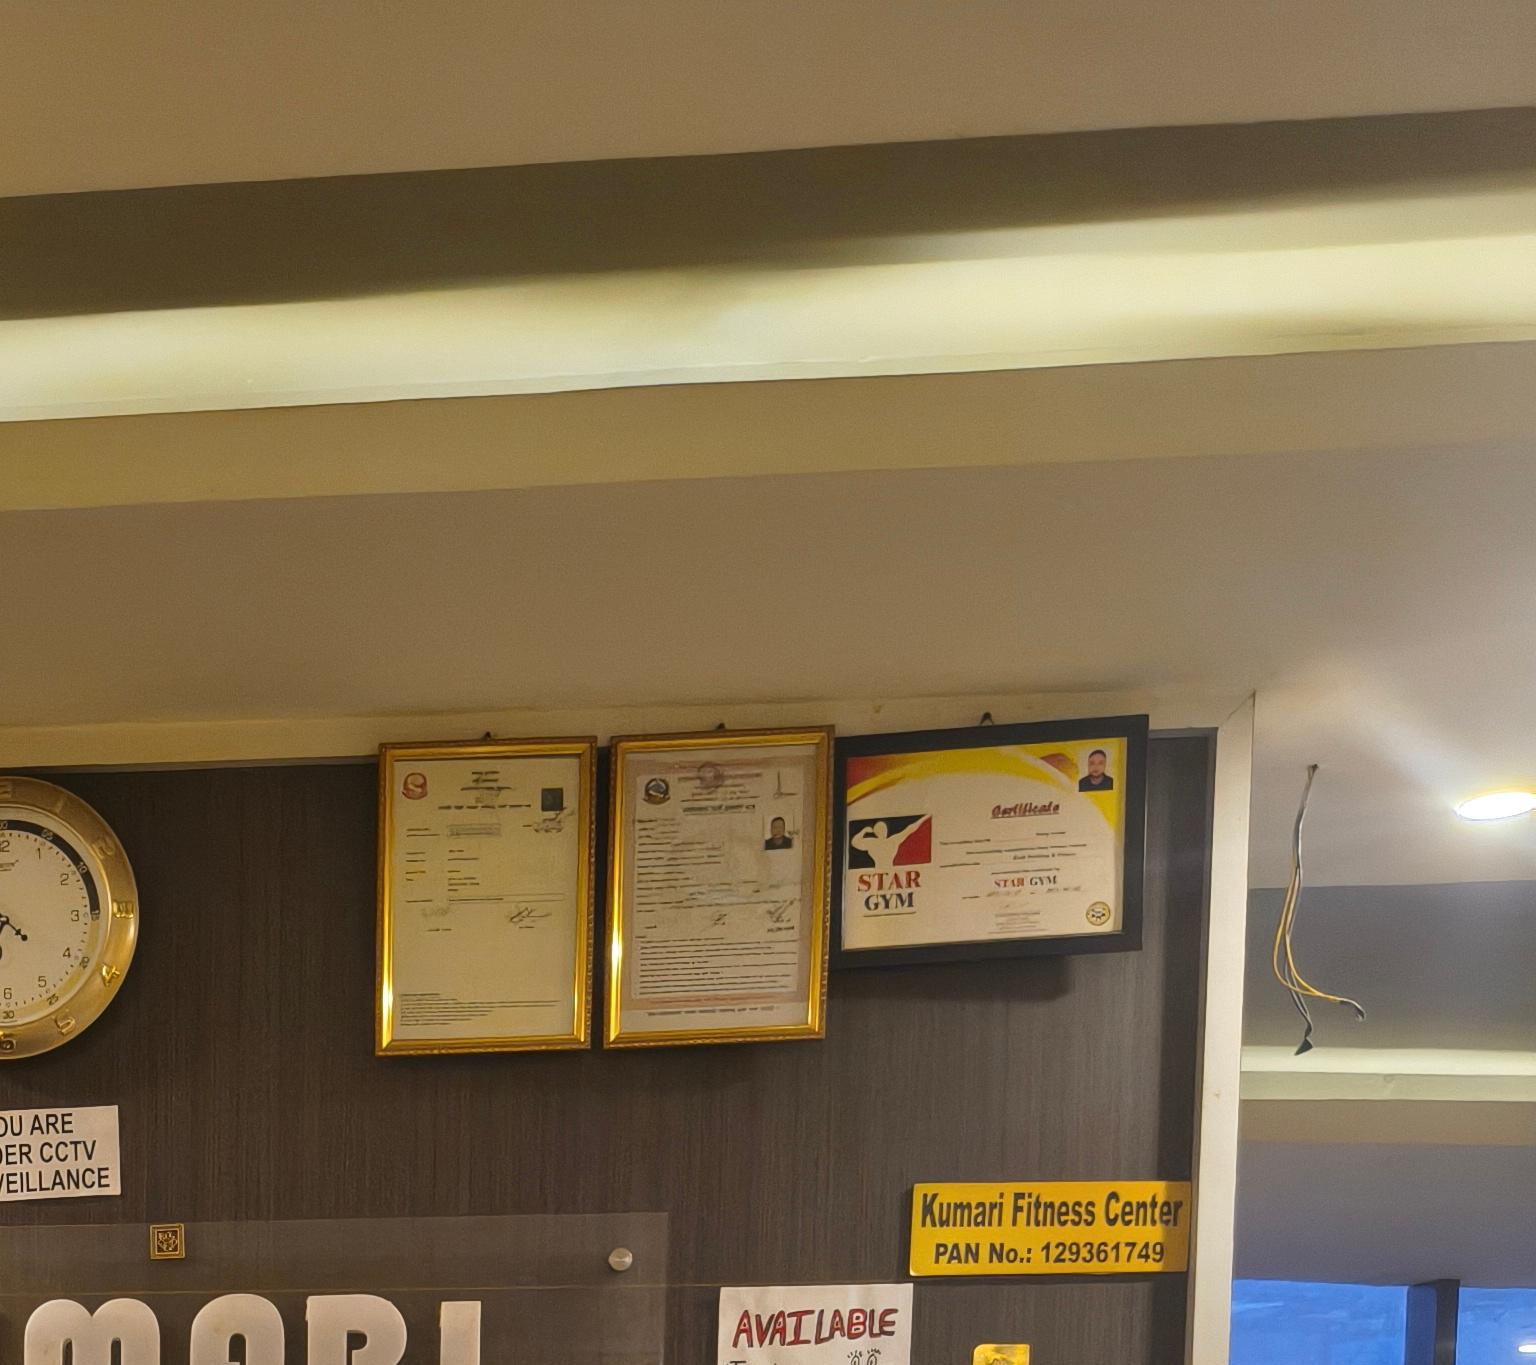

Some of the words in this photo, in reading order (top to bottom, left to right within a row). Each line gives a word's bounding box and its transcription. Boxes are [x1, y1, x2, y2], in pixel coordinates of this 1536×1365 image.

[36, 848, 41, 859] 1
[60, 873, 69, 886] 2
[857, 870, 921, 892] STAR
[1029, 874, 1058, 887] GYM
[864, 891, 914, 911] GYM
[70, 910, 80, 922] 3
[63, 947, 72, 958] 4
[38, 976, 46, 987] 5
[3, 988, 12, 1000] 6
[47, 993, 59, 1006] 25
[30, 1113, 74, 1136] ARE
[39, 1140, 96, 1163] CCTV
[921, 1192, 1004, 1228] Kumari
[1011, 1192, 1096, 1228] Fitness
[1104, 1190, 1183, 1227] Center
[934, 1242, 980, 1264] PAN
[1040, 1241, 1164, 1263] 129361749
[732, 1308, 899, 1348] AVAILABLE
